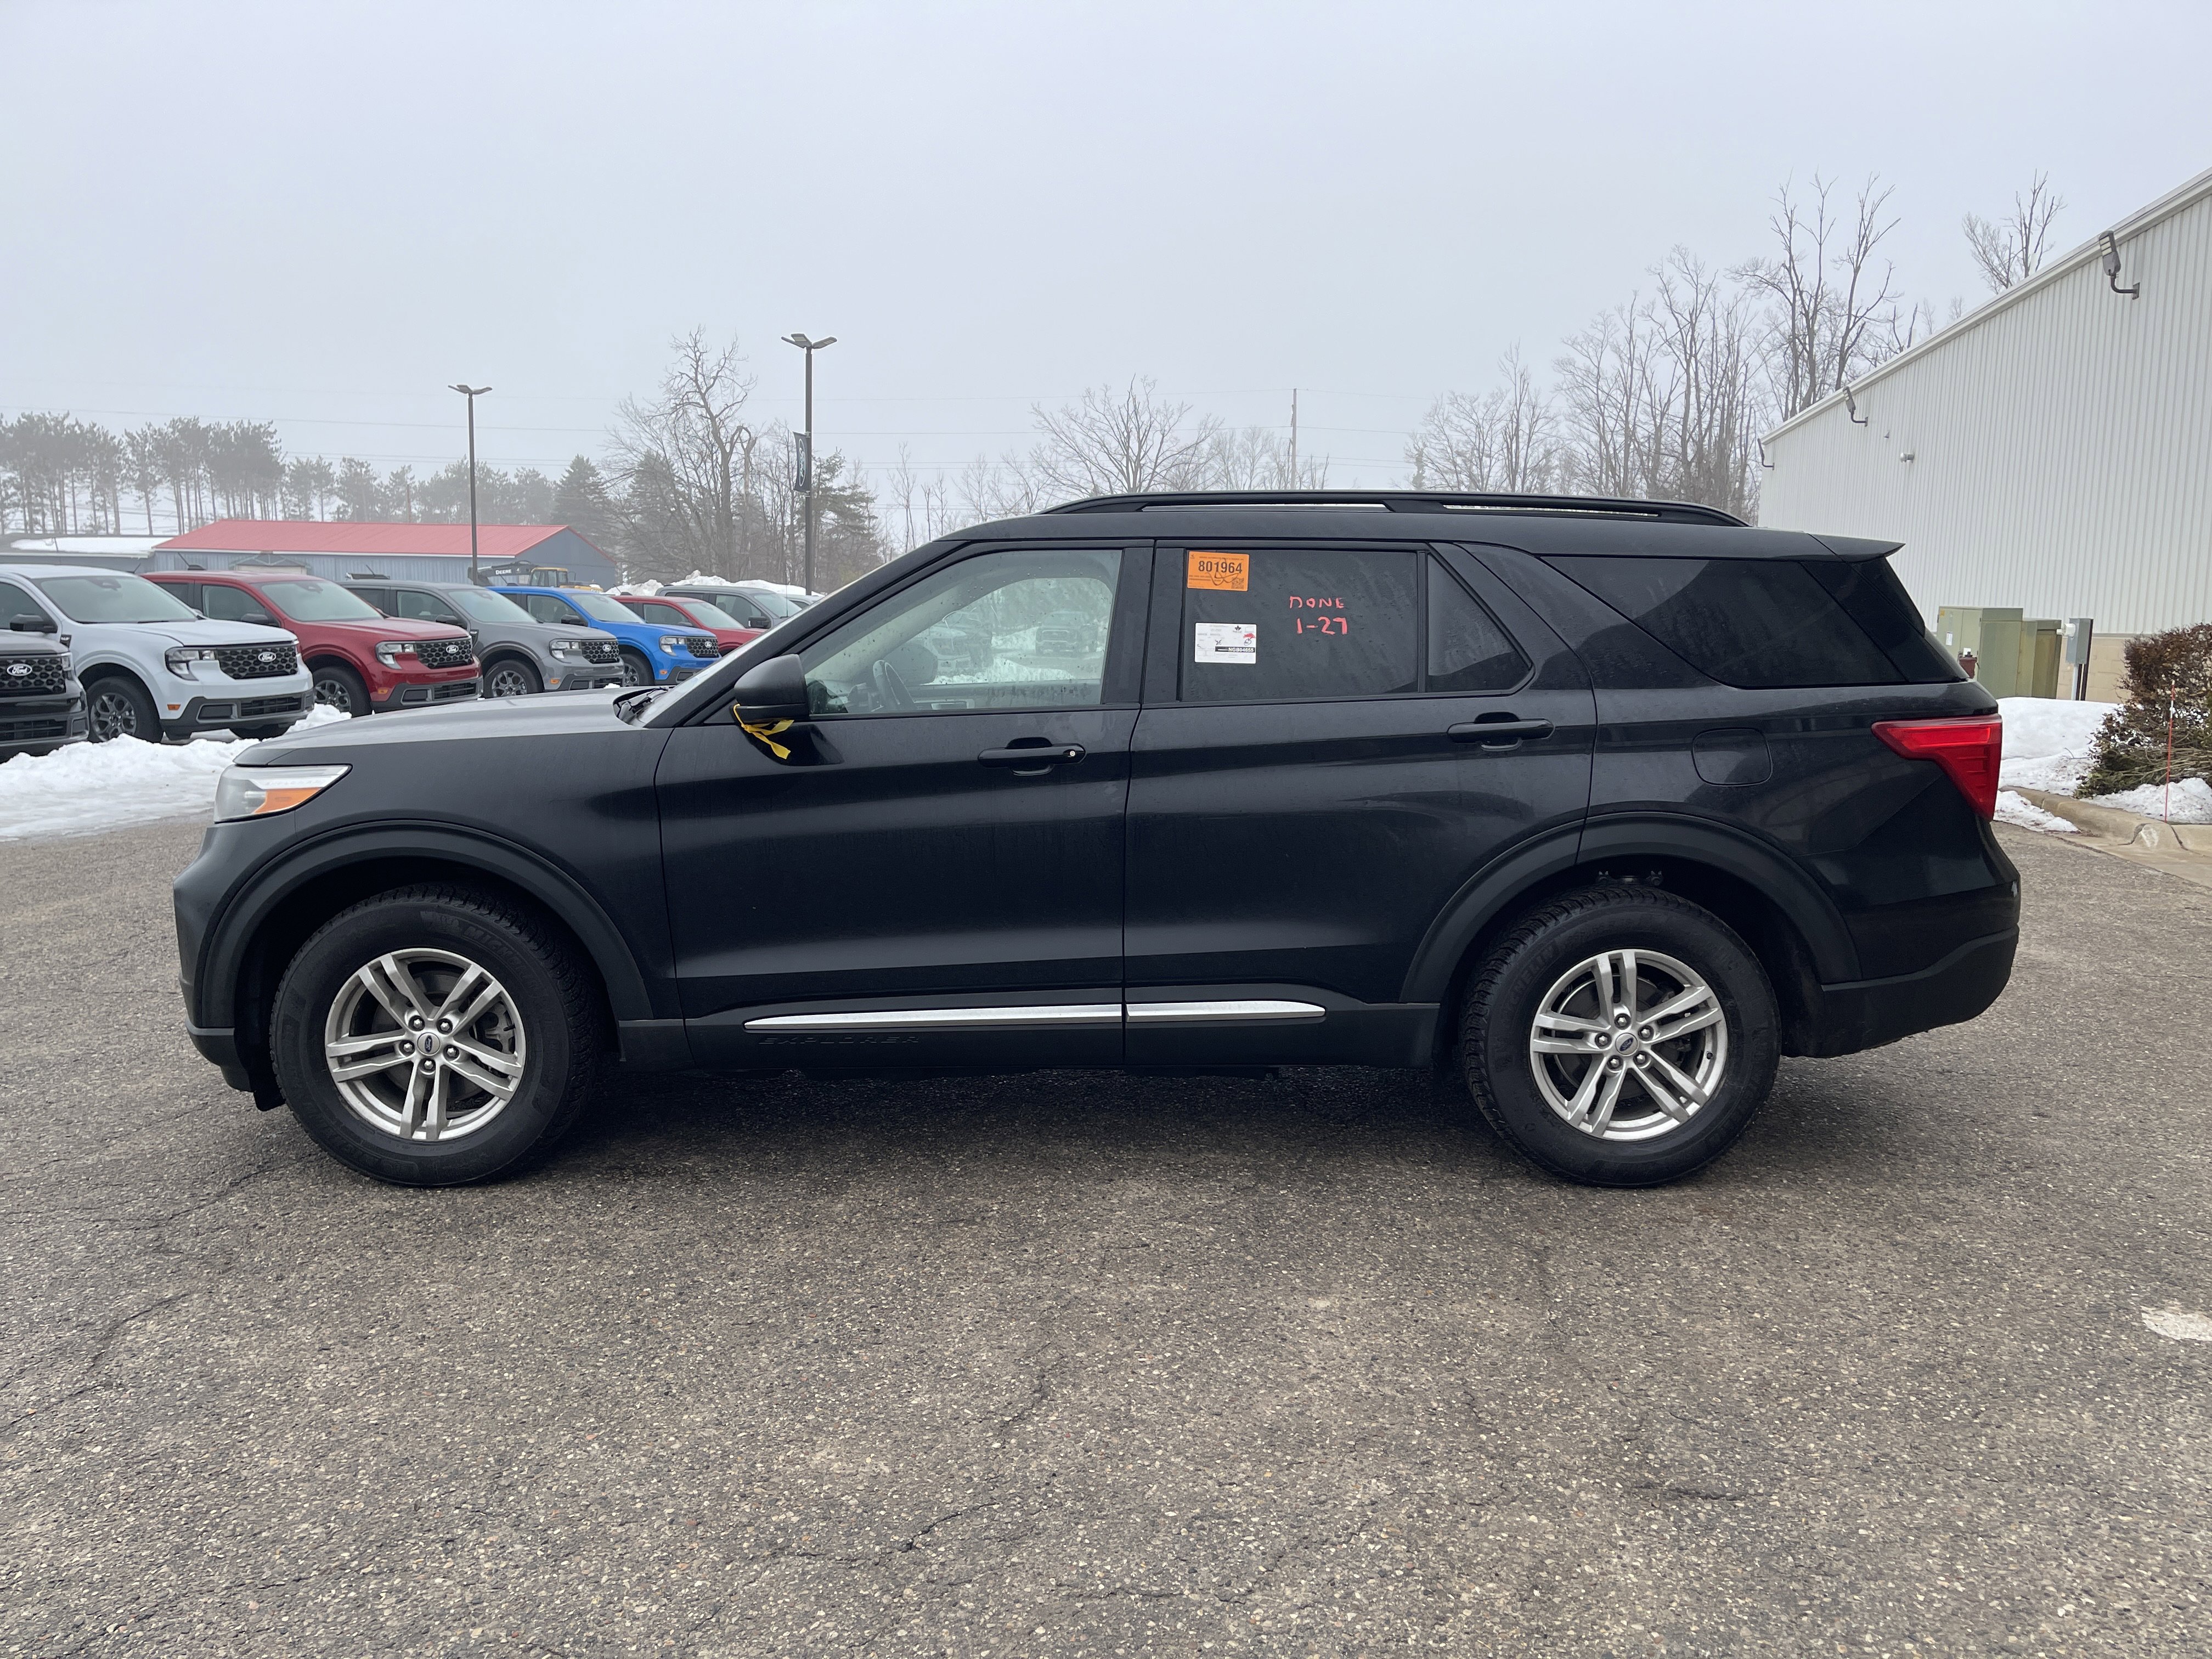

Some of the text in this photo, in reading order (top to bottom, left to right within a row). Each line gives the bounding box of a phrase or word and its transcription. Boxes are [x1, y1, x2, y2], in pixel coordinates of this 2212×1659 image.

[1198, 561, 1243, 574] 801964
[1290, 596, 1344, 609] DONE
[1297, 616, 1347, 635] 1-27
[11, 665, 28, 675] Ford
[758, 1036, 919, 1045] EXPLORER
